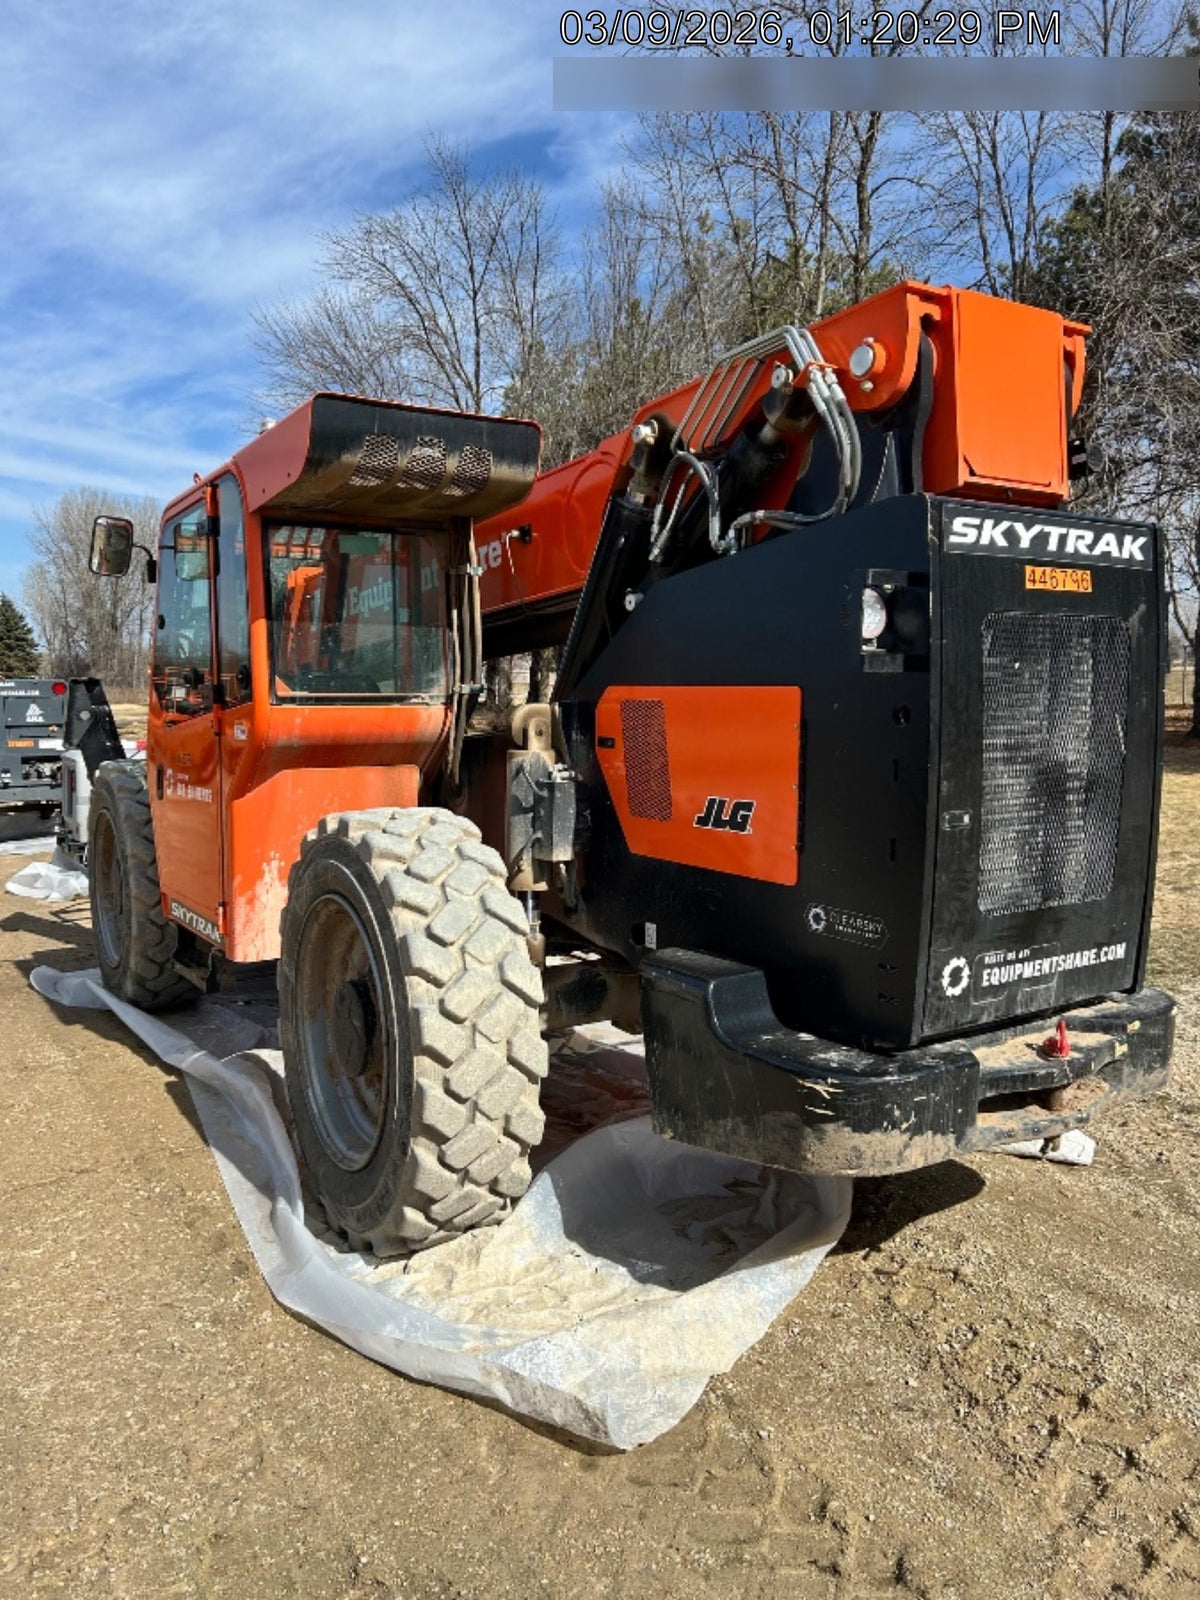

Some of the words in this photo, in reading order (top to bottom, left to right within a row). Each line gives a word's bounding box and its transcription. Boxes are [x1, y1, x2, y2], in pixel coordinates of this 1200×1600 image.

[948, 516, 1148, 561] SKYTRAK
[1027, 568, 1090, 591] 446796
[693, 795, 756, 834] JLG
[981, 942, 1127, 988] EQUIPMENTSHARE.COM
